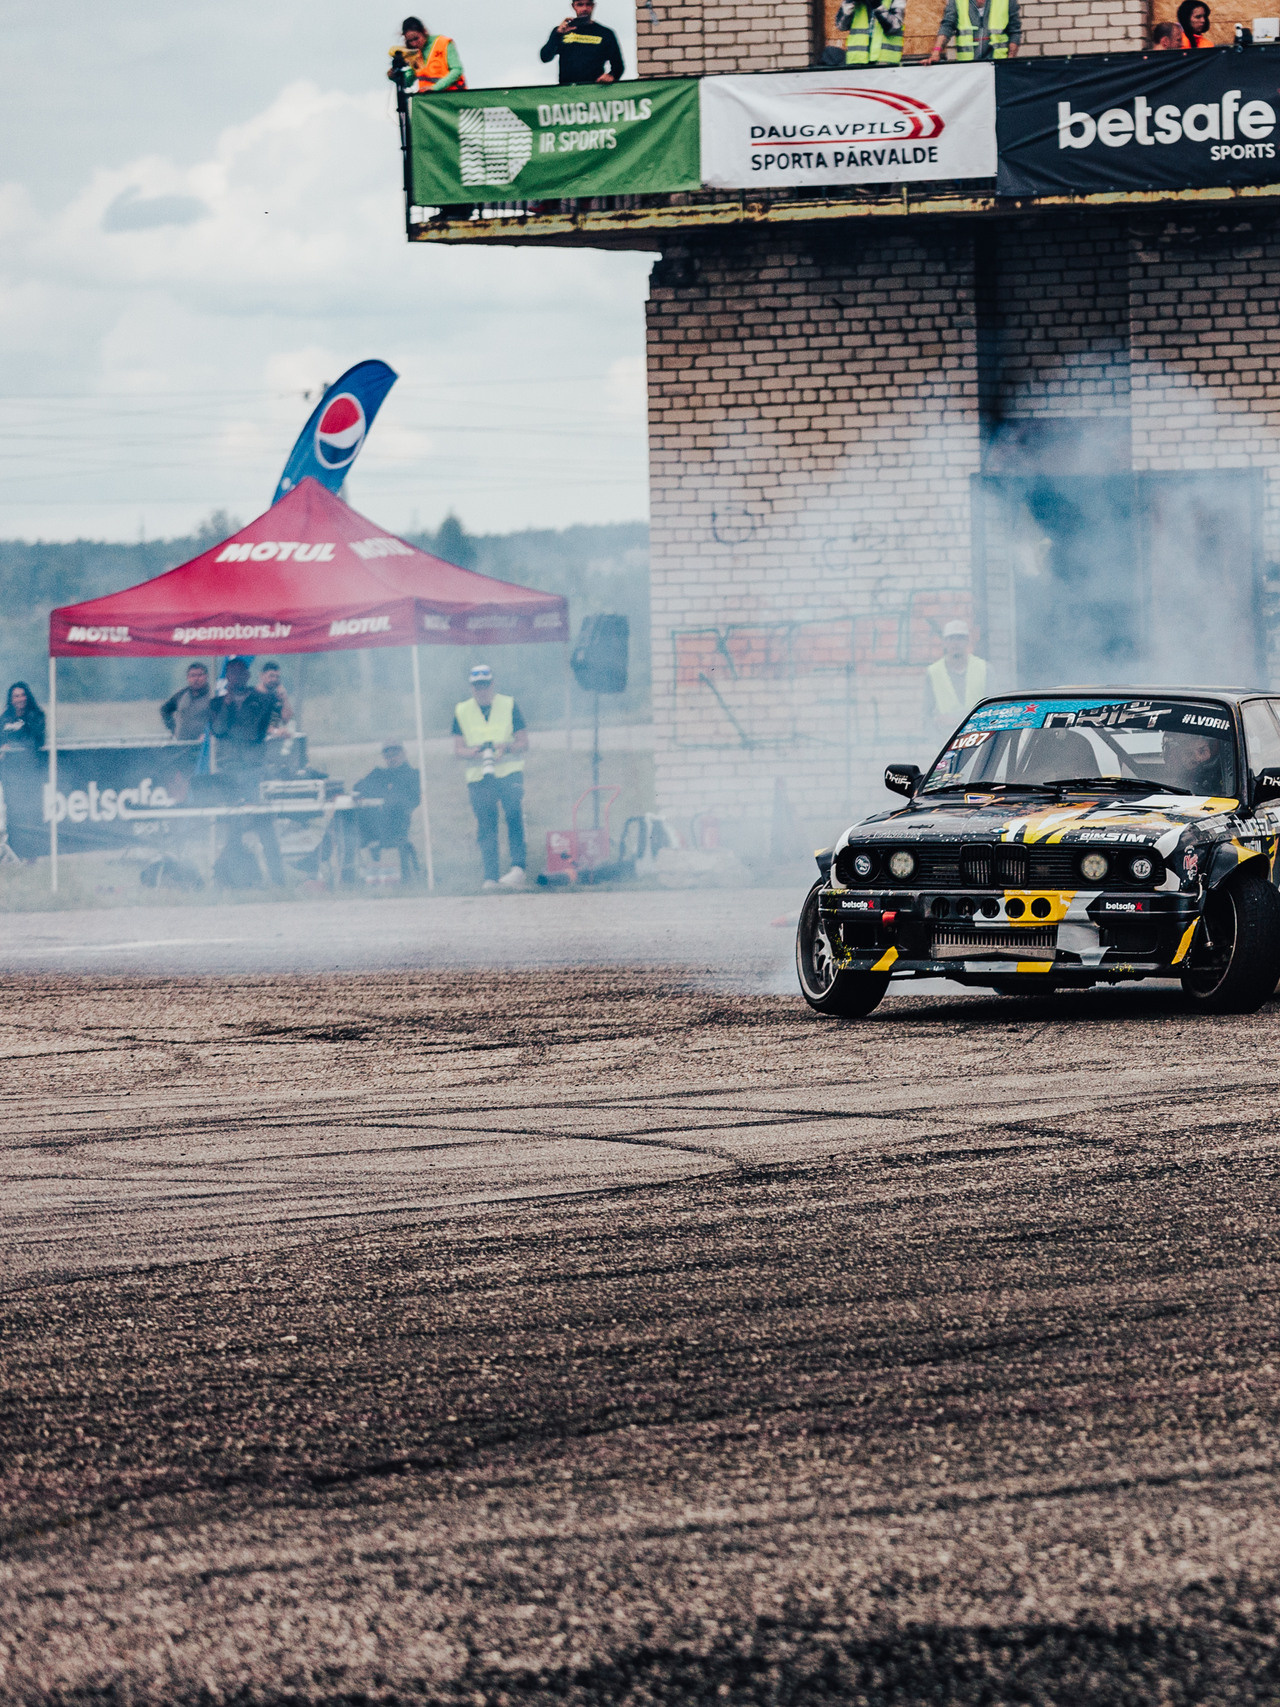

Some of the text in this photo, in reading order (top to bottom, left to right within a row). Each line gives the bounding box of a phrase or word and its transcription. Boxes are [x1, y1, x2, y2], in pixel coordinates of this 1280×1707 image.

[537, 98, 653, 127] DAUGAVPILS
[1058, 90, 1276, 150] betsafe
[751, 121, 906, 138] DAUGAVPILS
[539, 128, 617, 154] IR SPORTS
[1210, 142, 1276, 161] SPORTS
[751, 146, 938, 171] SPORTA PĀRVALDE
[216, 541, 336, 562] MOTUL
[67, 626, 132, 642] MOTUL
[172, 622, 292, 644] apemotors.lv
[328, 616, 391, 637] MOTUL
[951, 732, 990, 750] LV87
[1105, 902, 1136, 910] betsafe
